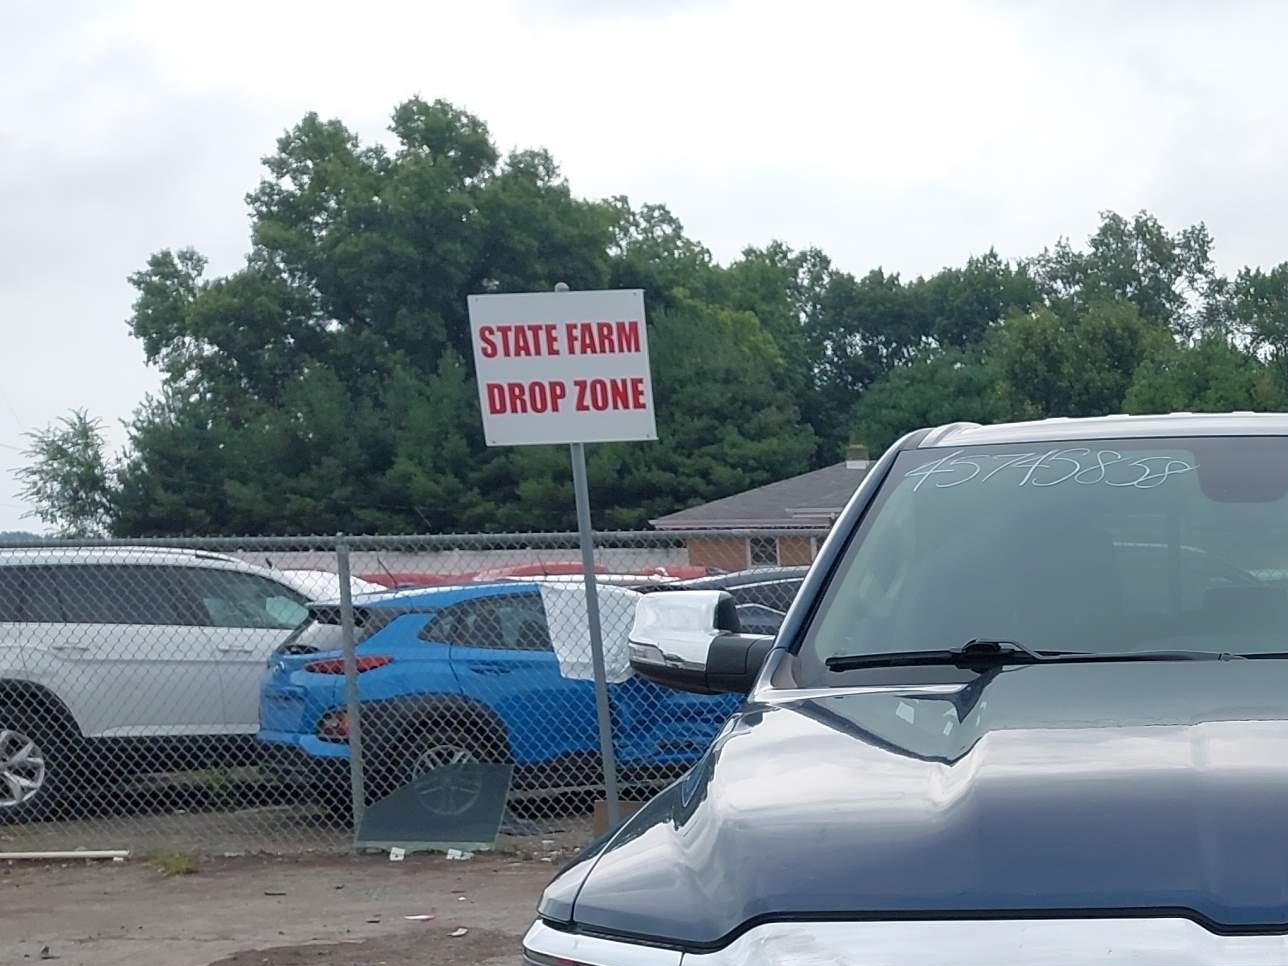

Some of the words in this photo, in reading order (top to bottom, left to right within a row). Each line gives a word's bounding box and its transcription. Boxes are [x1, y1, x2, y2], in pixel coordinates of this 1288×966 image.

[479, 324, 560, 358] STATE
[565, 321, 641, 355] FARM
[486, 381, 566, 415] DROP
[573, 378, 647, 412] ZONE
[904, 448, 1200, 491] 45745858
